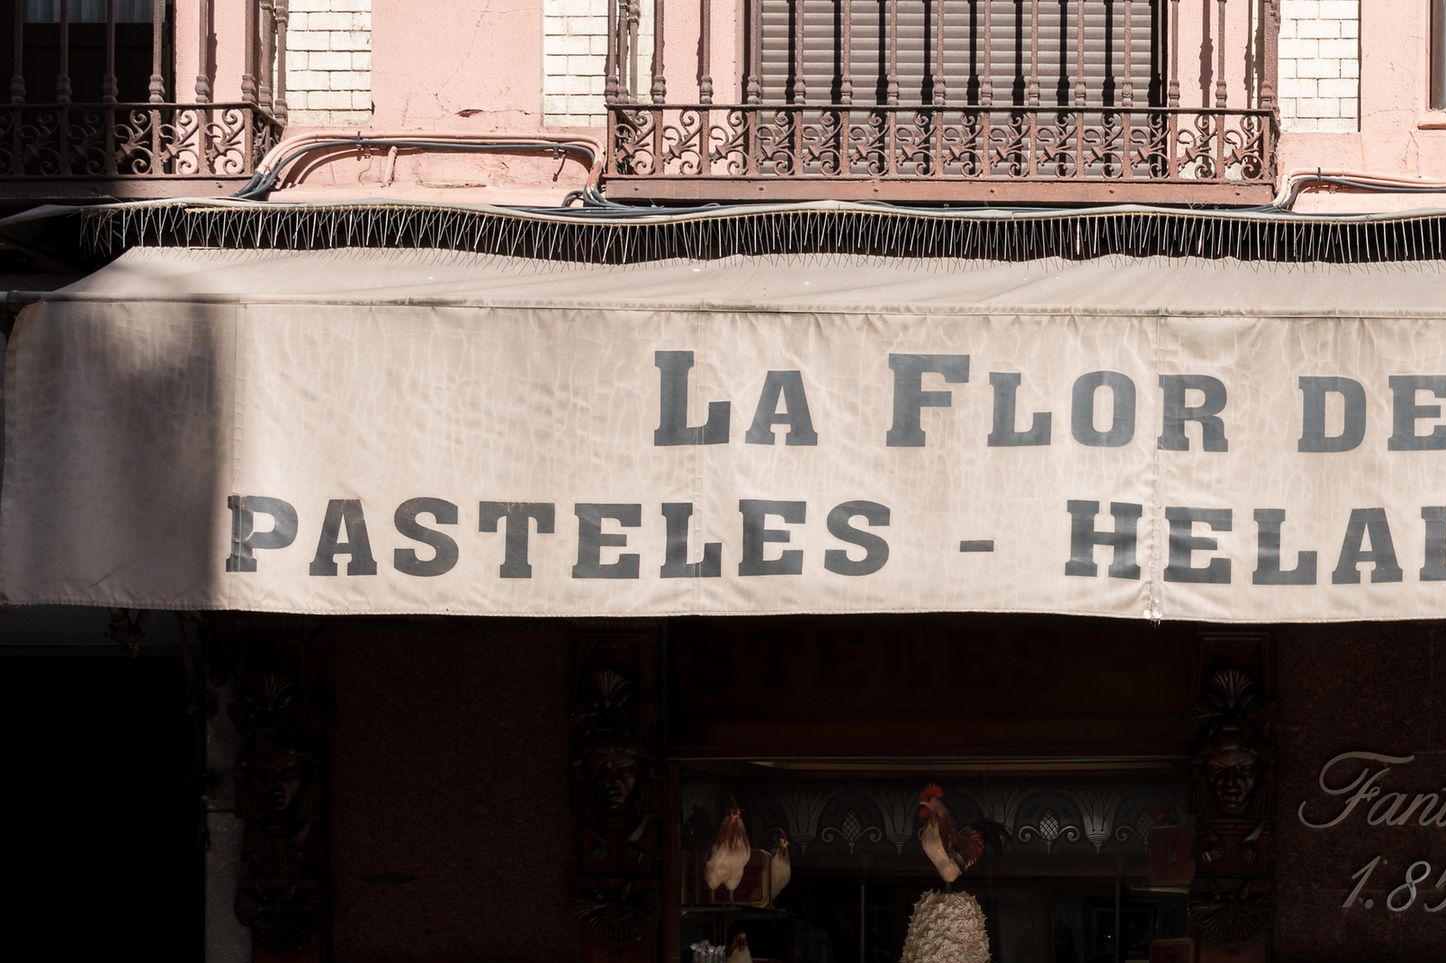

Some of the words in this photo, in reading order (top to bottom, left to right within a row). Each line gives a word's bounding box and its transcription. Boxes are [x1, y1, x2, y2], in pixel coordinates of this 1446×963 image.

[655, 351, 817, 446] LA
[886, 353, 1229, 452] FLOR
[226, 495, 891, 578] PASTELES
